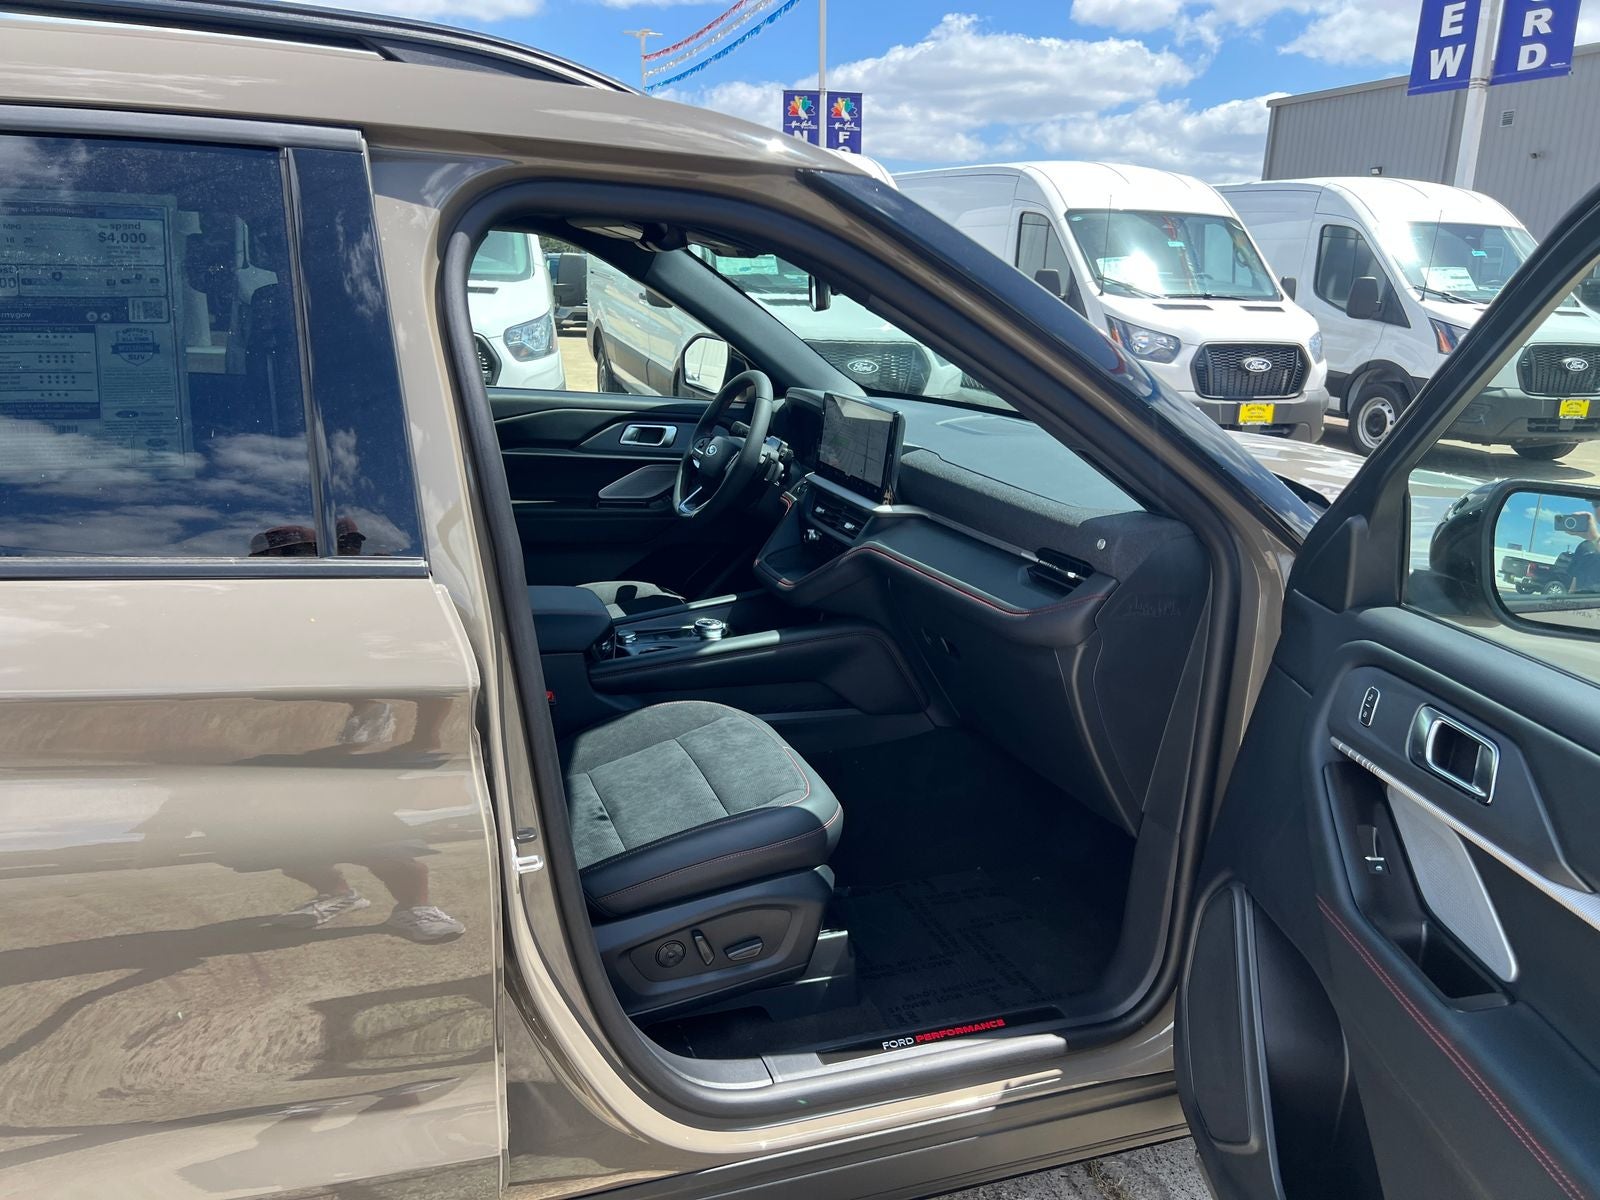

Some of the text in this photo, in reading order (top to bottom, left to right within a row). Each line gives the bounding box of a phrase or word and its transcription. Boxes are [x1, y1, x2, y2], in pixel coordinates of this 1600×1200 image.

[1516, 0, 1553, 72] RD
[98, 231, 147, 244] $4,000
[109, 222, 142, 231] spend
[882, 1019, 1006, 1050] FORD PERFORMANCE
